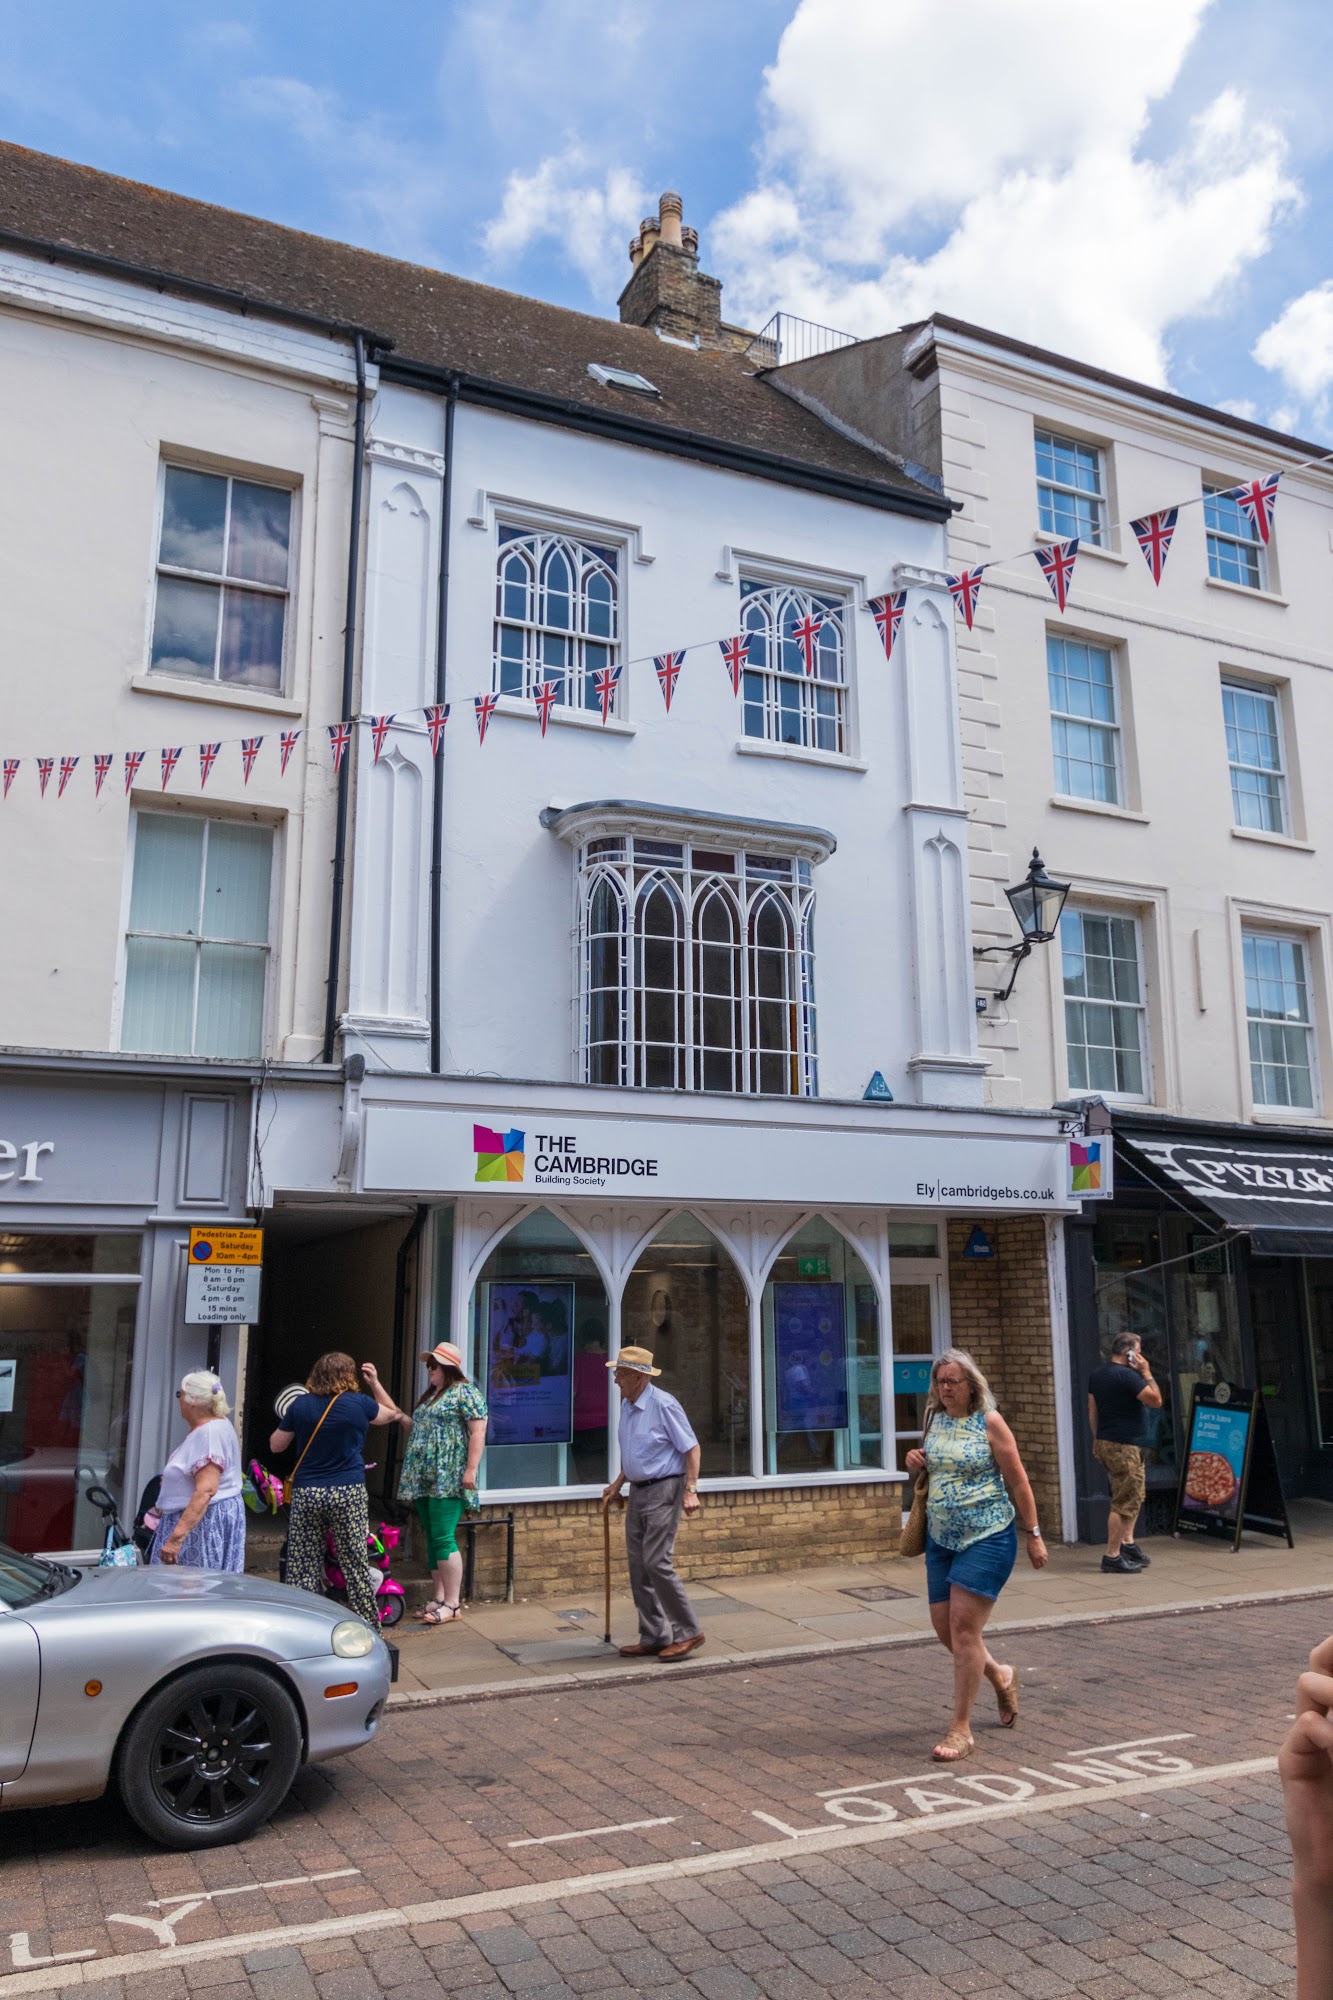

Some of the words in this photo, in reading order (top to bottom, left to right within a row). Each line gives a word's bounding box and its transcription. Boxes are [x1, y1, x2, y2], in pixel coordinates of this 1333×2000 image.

[535, 1135, 576, 1154] THE
[534, 1155, 658, 1176] CAMBRIDGE
[535, 1175, 571, 1186] Building
[573, 1177, 606, 1187] Society
[916, 1183, 935, 1198] Ely
[941, 1185, 1055, 1200] cambridgebs.co.uk
[196, 1230, 237, 1239] Pedestrian
[239, 1231, 257, 1239] Zone
[220, 1242, 254, 1251] Saturday
[216, 1252, 235, 1260] 10am
[242, 1253, 259, 1261] 4pm
[206, 1284, 240, 1294] Saturday
[198, 1313, 228, 1321] Loading
[230, 1313, 247, 1321] only
[752, 1751, 1194, 1838] LOADING
